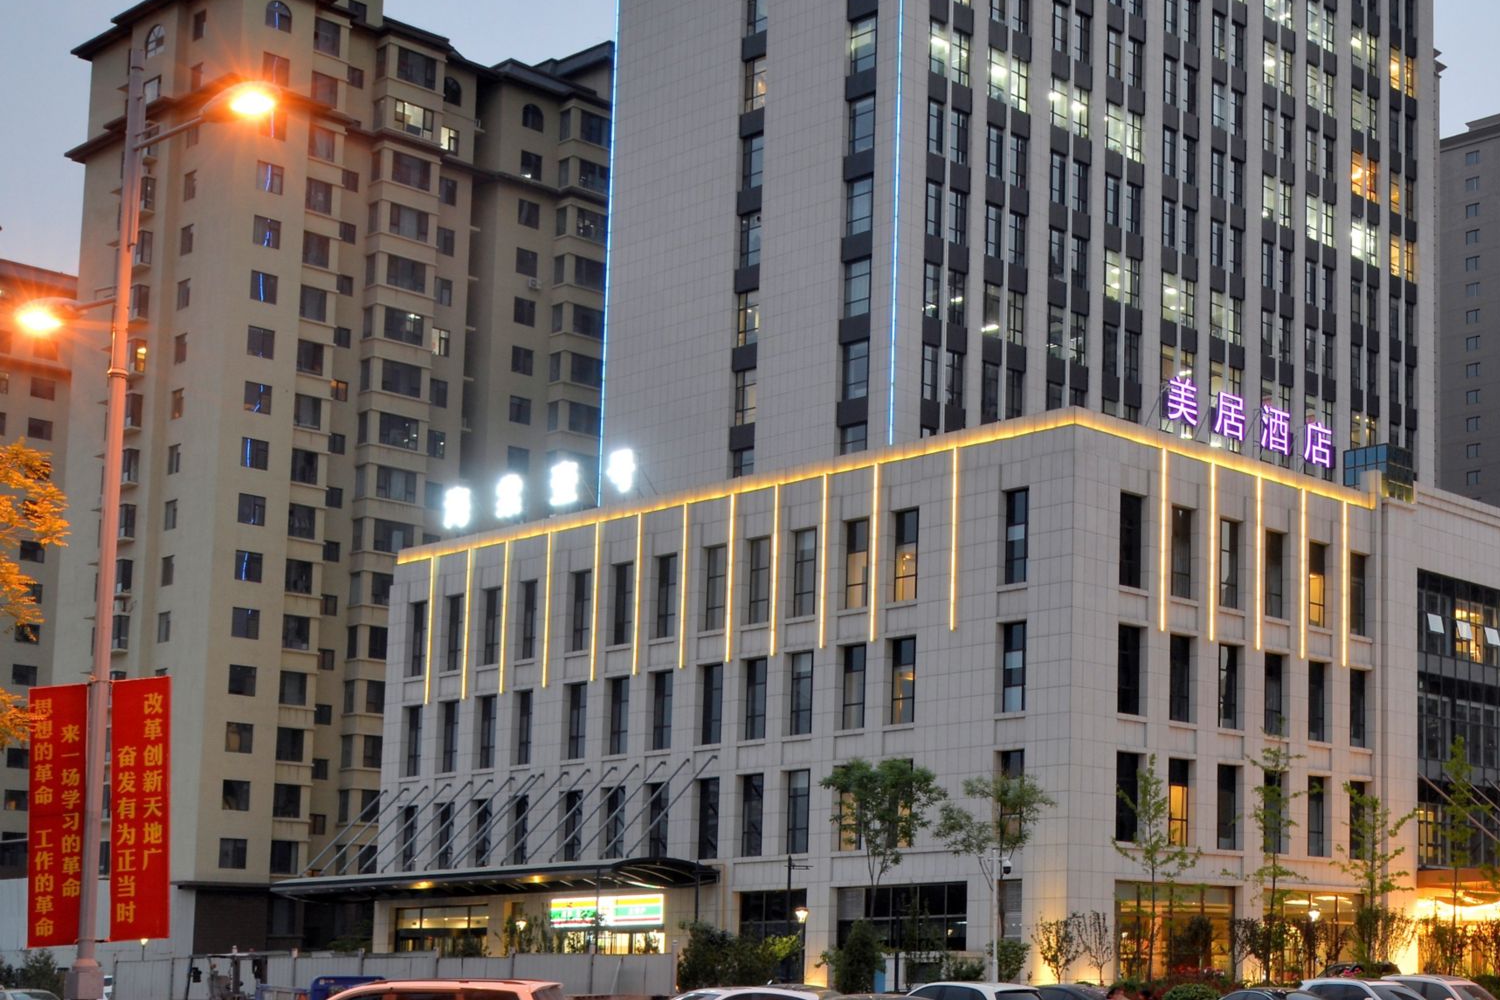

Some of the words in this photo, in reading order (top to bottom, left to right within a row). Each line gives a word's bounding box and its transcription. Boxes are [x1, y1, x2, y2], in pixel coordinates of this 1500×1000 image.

[1167, 375, 1333, 470] 美居酒店
[61, 724, 81, 898] 来一场学习的革命
[116, 745, 137, 923] 奋发有为正当时
[142, 692, 163, 871] 改革创新天地广
[34, 829, 54, 938] 工作的革命
